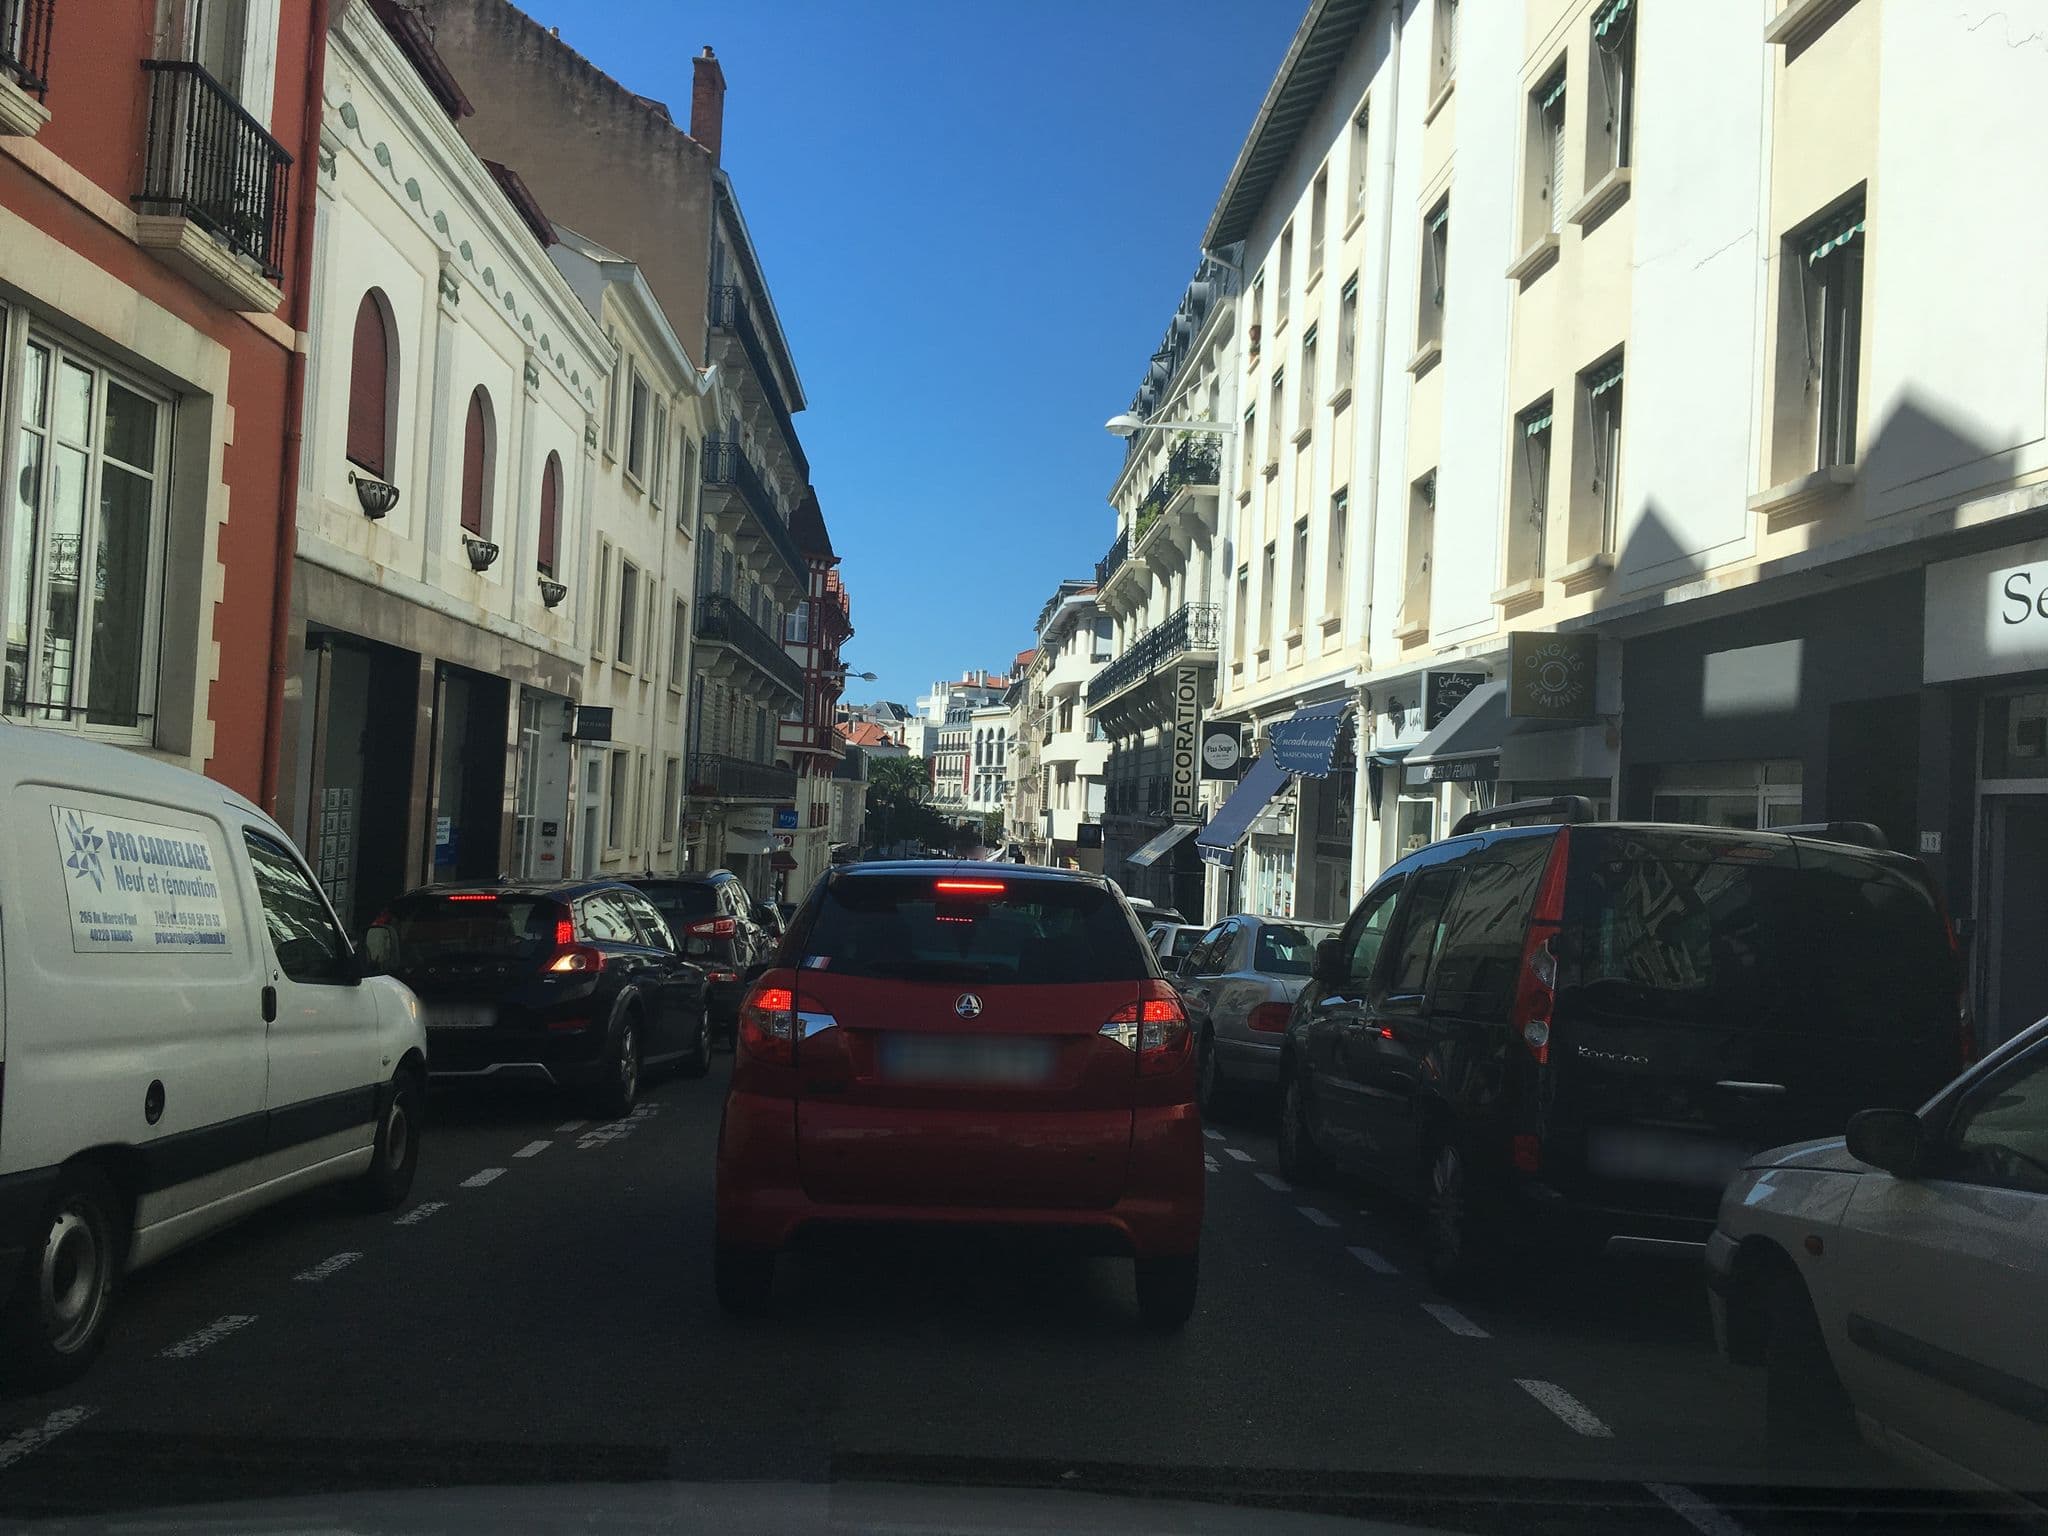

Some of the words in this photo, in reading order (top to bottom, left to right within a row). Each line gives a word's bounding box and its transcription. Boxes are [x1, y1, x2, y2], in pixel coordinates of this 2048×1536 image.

[1525, 643, 1585, 672] ONGLES
[1173, 669, 1197, 816] DECORATION
[1276, 729, 1333, 748] Encadrements
[106, 830, 139, 862] PRO
[138, 834, 211, 871] CARRELAGE
[114, 865, 145, 892] Neuf
[148, 872, 159, 893] et
[161, 870, 218, 898] rénovation
